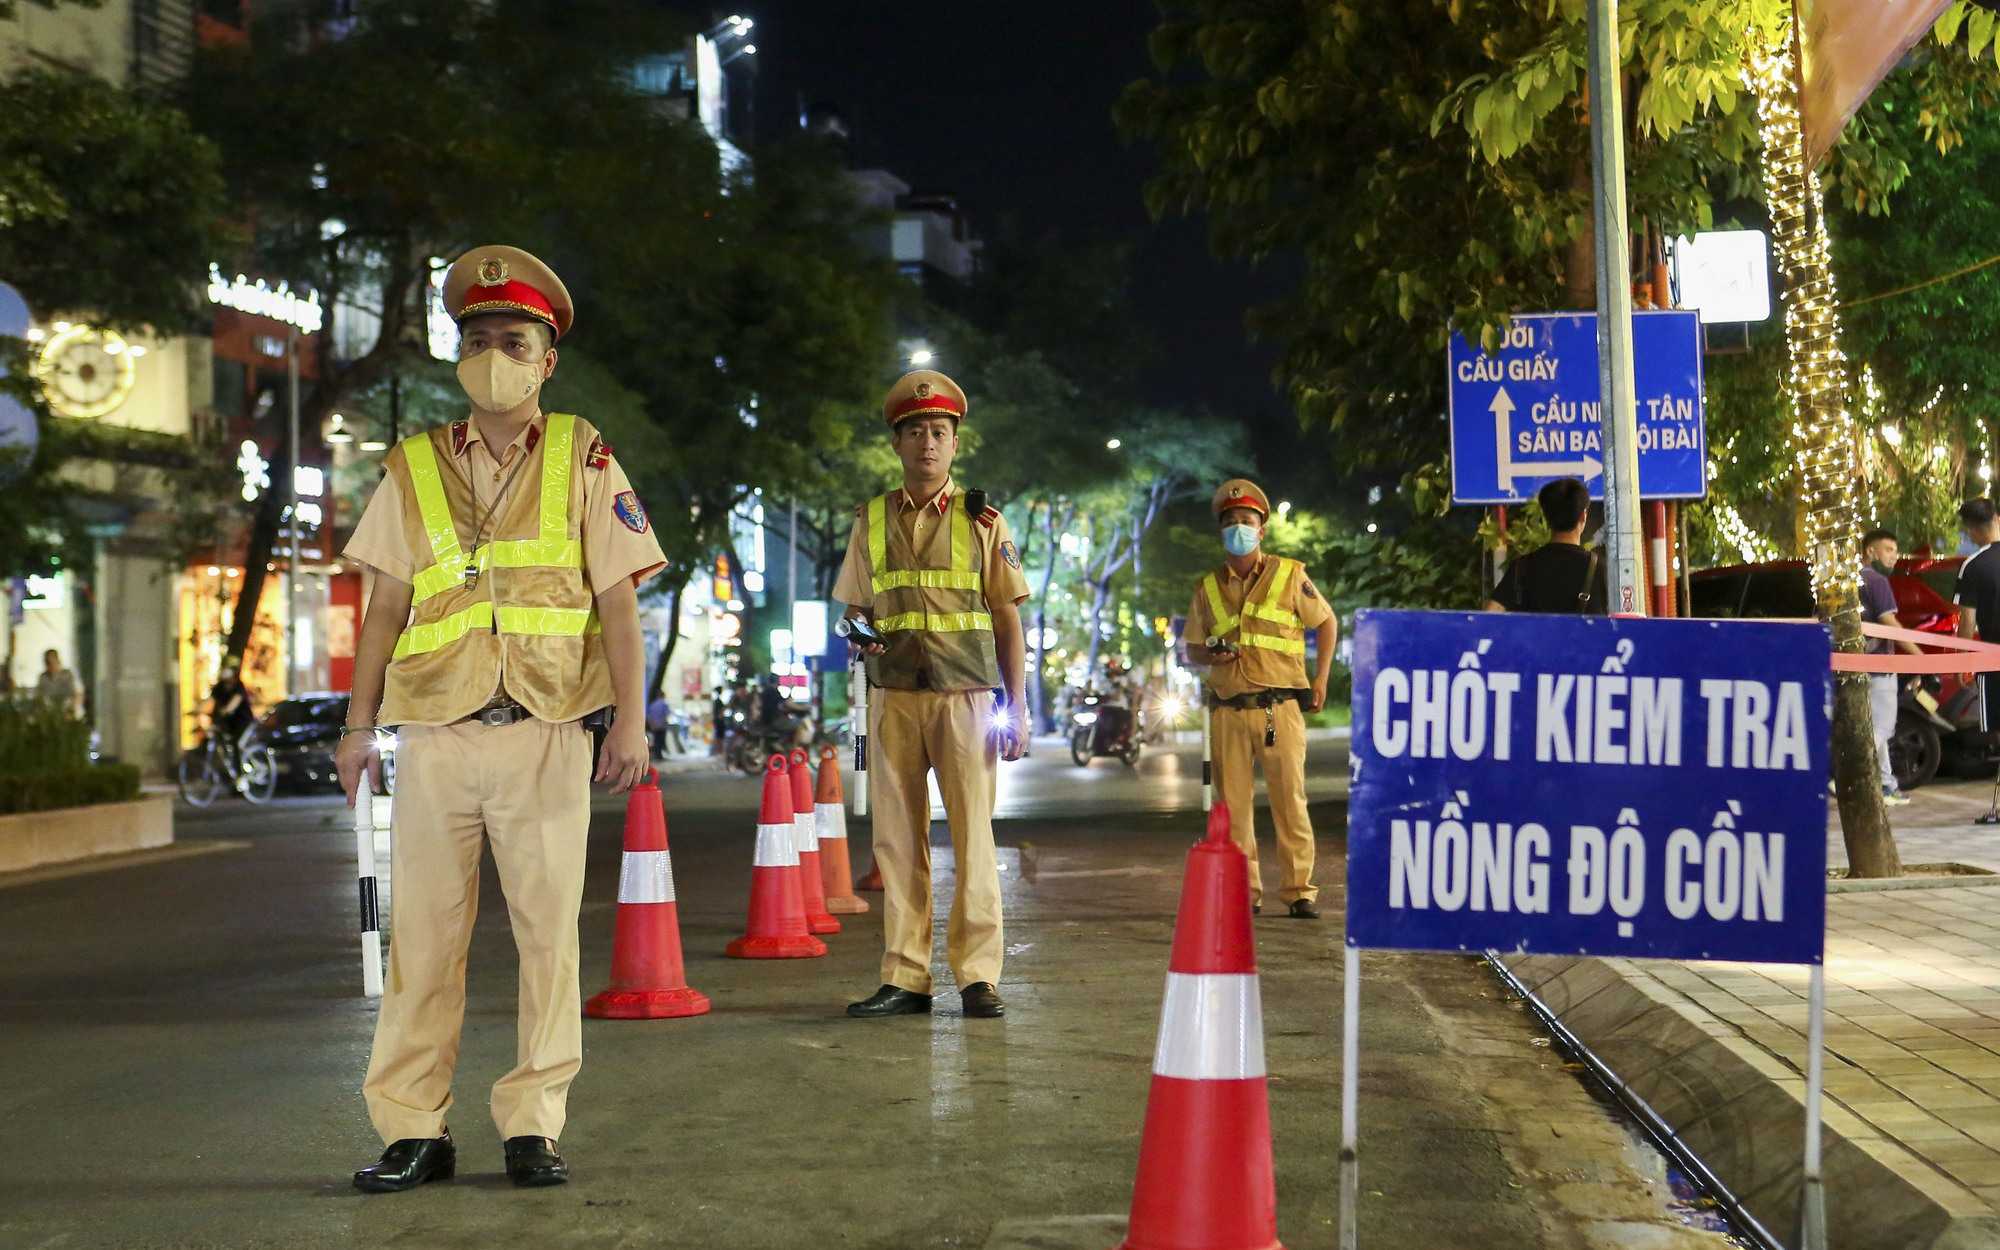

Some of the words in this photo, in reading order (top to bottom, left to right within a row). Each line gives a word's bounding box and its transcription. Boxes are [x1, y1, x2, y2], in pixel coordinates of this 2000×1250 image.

[1457, 353, 1503, 382] CẦU
[1508, 350, 1559, 381] GIẤY
[1531, 393, 1576, 424] CẦU
[1647, 393, 1692, 421] TÂN
[1518, 426, 1566, 453] SÂN
[1570, 431, 1602, 452] BA
[1637, 423, 1658, 455] ỘI
[1661, 423, 1697, 450] BÀI
[1371, 638, 1521, 762] CHỐT
[1535, 638, 1683, 767] KIỂM
[1700, 678, 1812, 771] TRA
[1388, 790, 1551, 915] NỒNG
[1566, 807, 1646, 938] ĐỘ
[1664, 799, 1785, 923] CỒN
